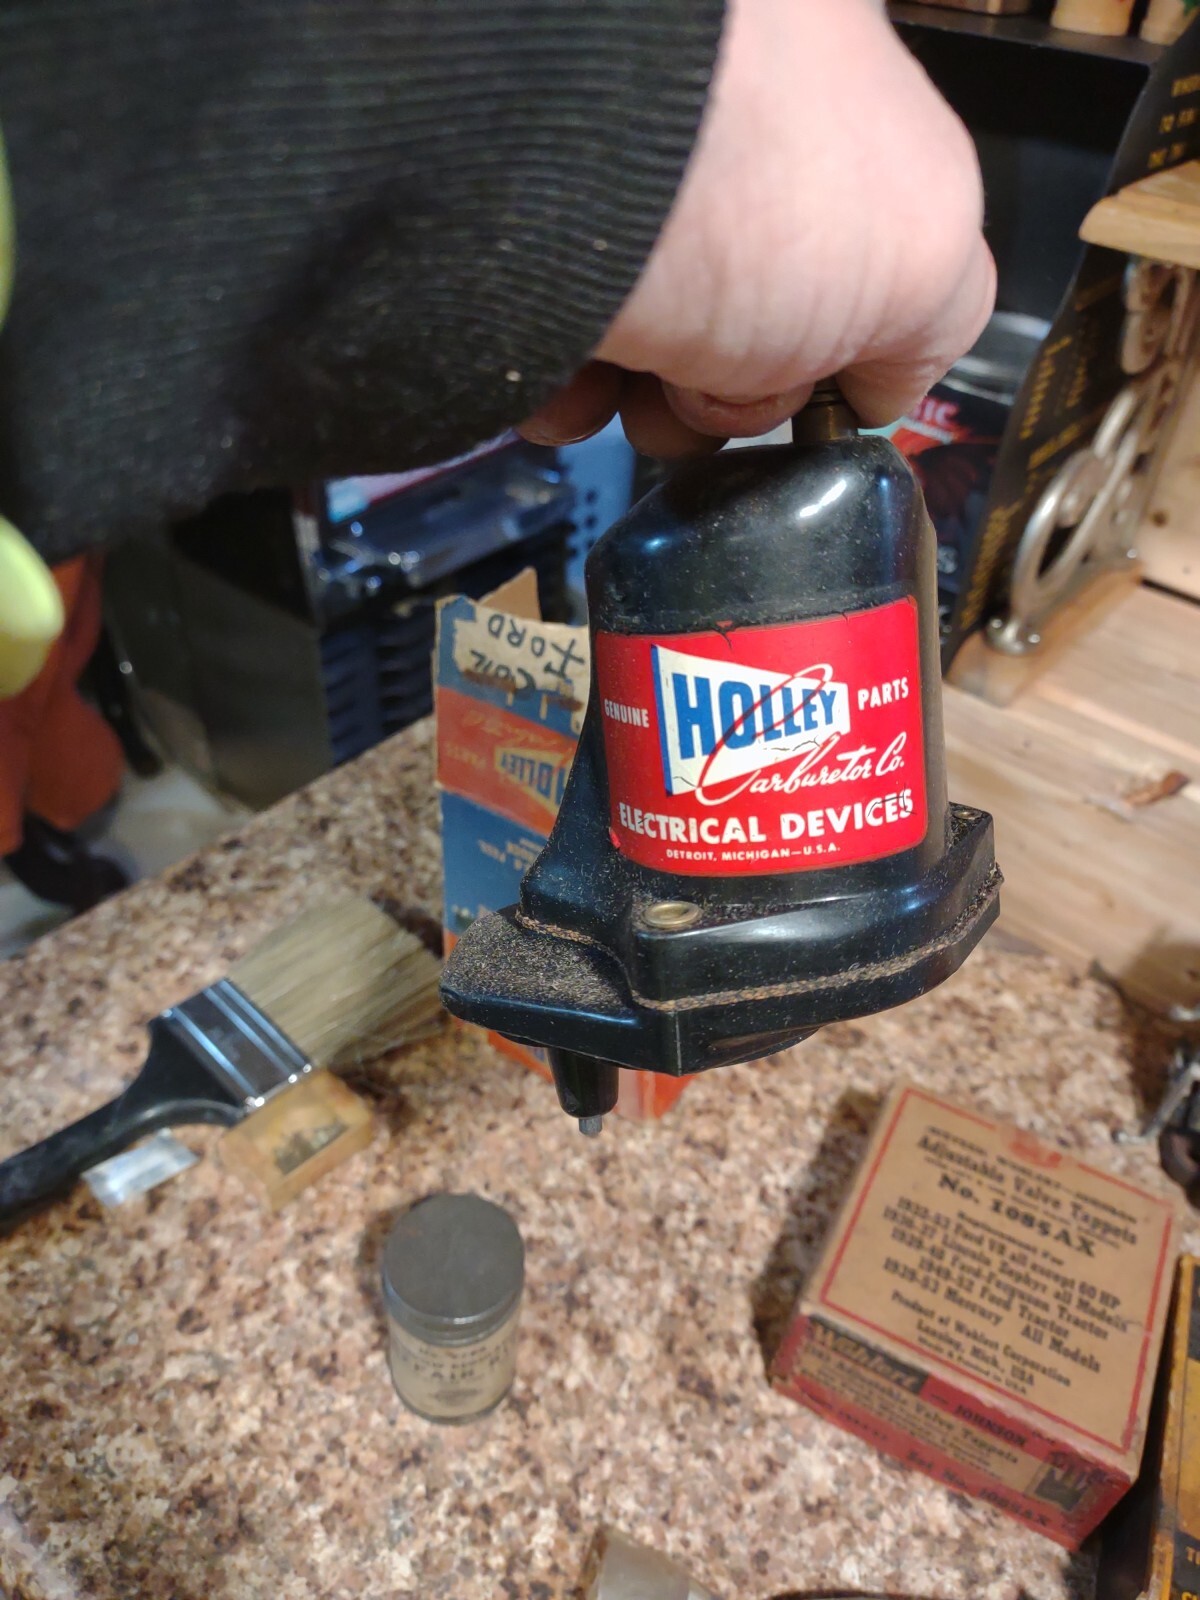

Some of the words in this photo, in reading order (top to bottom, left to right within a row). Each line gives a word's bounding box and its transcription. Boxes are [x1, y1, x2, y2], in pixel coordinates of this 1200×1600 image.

[487, 614, 585, 679] FORD
[856, 676, 910, 712] PARTS
[604, 698, 650, 729] GENUINE
[671, 672, 837, 761] HOLLEY
[878, 731, 906, 777] Co.
[618, 802, 767, 845] ELECTRICAL
[779, 788, 914, 840] DEVICES
[665, 848, 719, 862] DETROIT,
[937, 1172, 982, 1204] No.
[1077, 1279, 1097, 1300] 60
[1098, 1289, 1121, 1311] HP
[1017, 1303, 1070, 1339] Tractor
[1055, 1304, 1109, 1340] Tractor
[1047, 1335, 1102, 1373] Models
